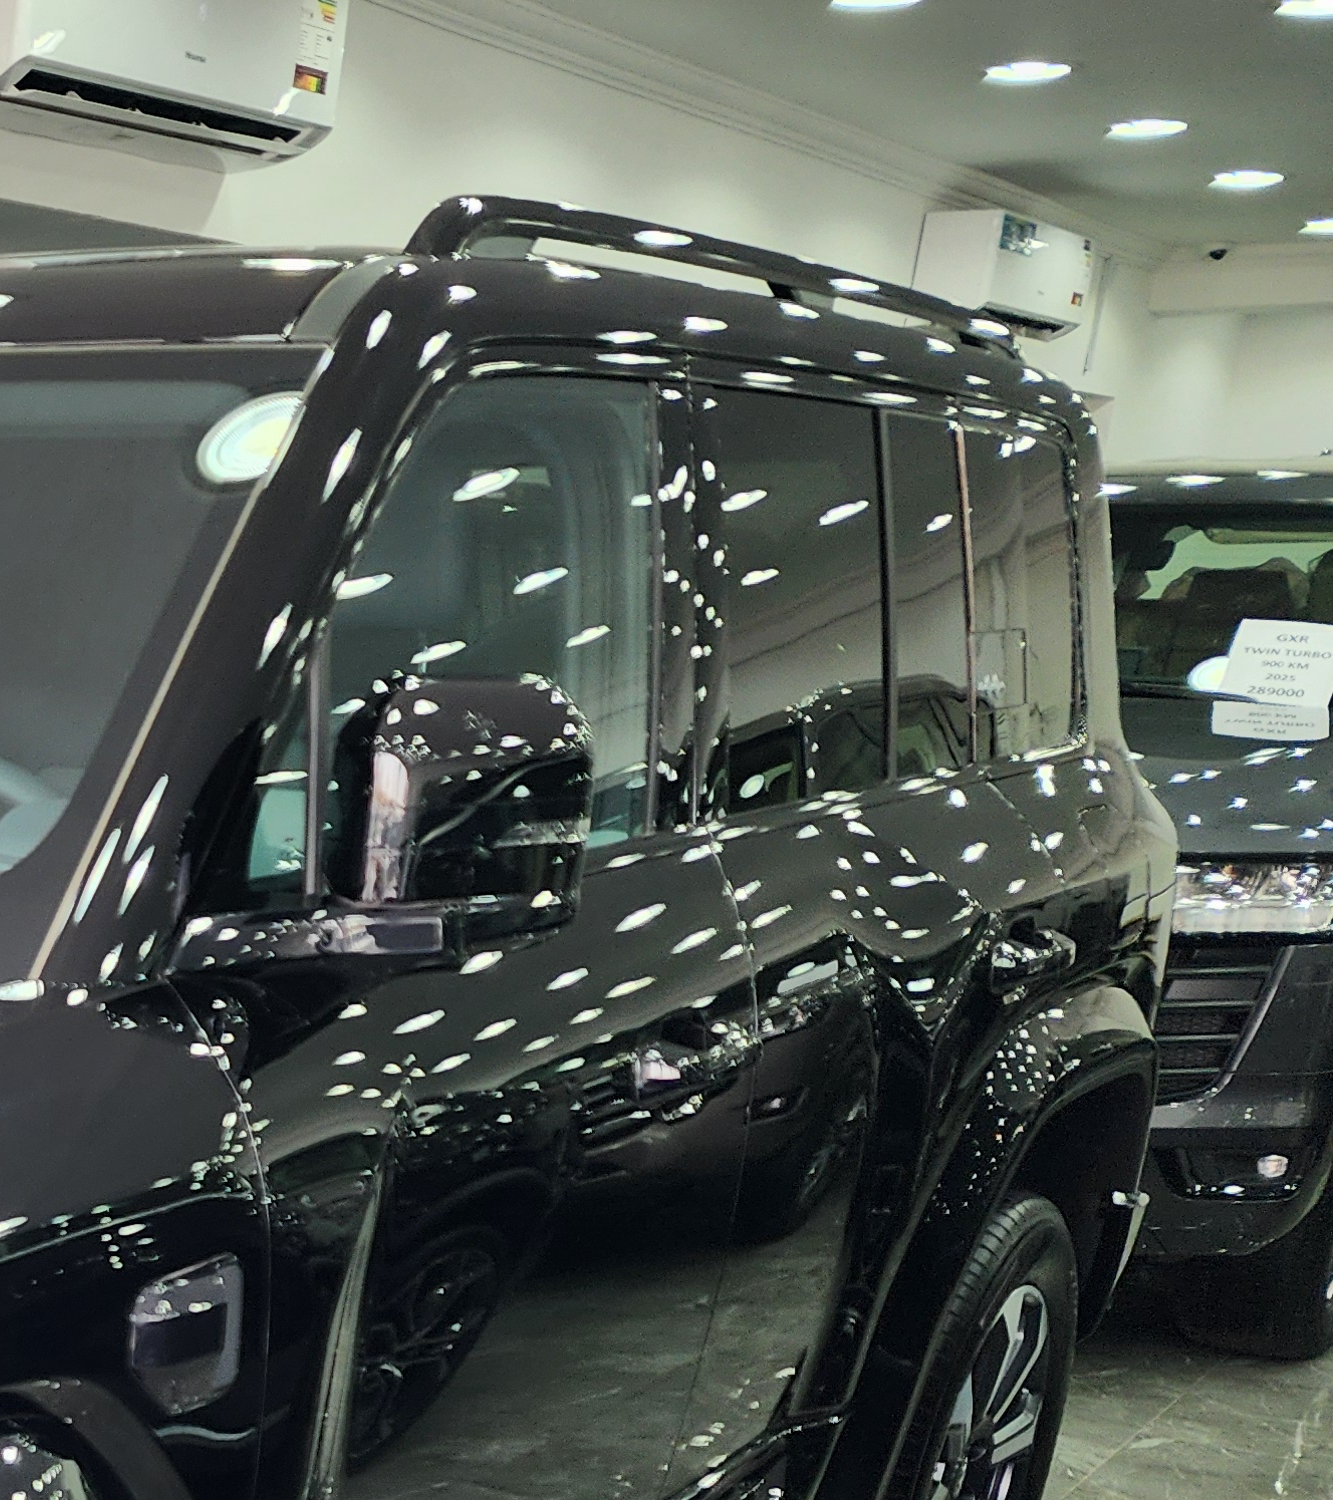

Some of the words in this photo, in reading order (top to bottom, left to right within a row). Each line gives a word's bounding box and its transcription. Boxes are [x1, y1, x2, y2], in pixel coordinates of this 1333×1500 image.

[1276, 633, 1310, 644] GXR
[1244, 646, 1281, 655] TWIN
[1285, 648, 1332, 659] TURBO
[1287, 662, 1309, 670] KM
[1264, 673, 1296, 682] 2025
[1246, 685, 1305, 698] 289000
